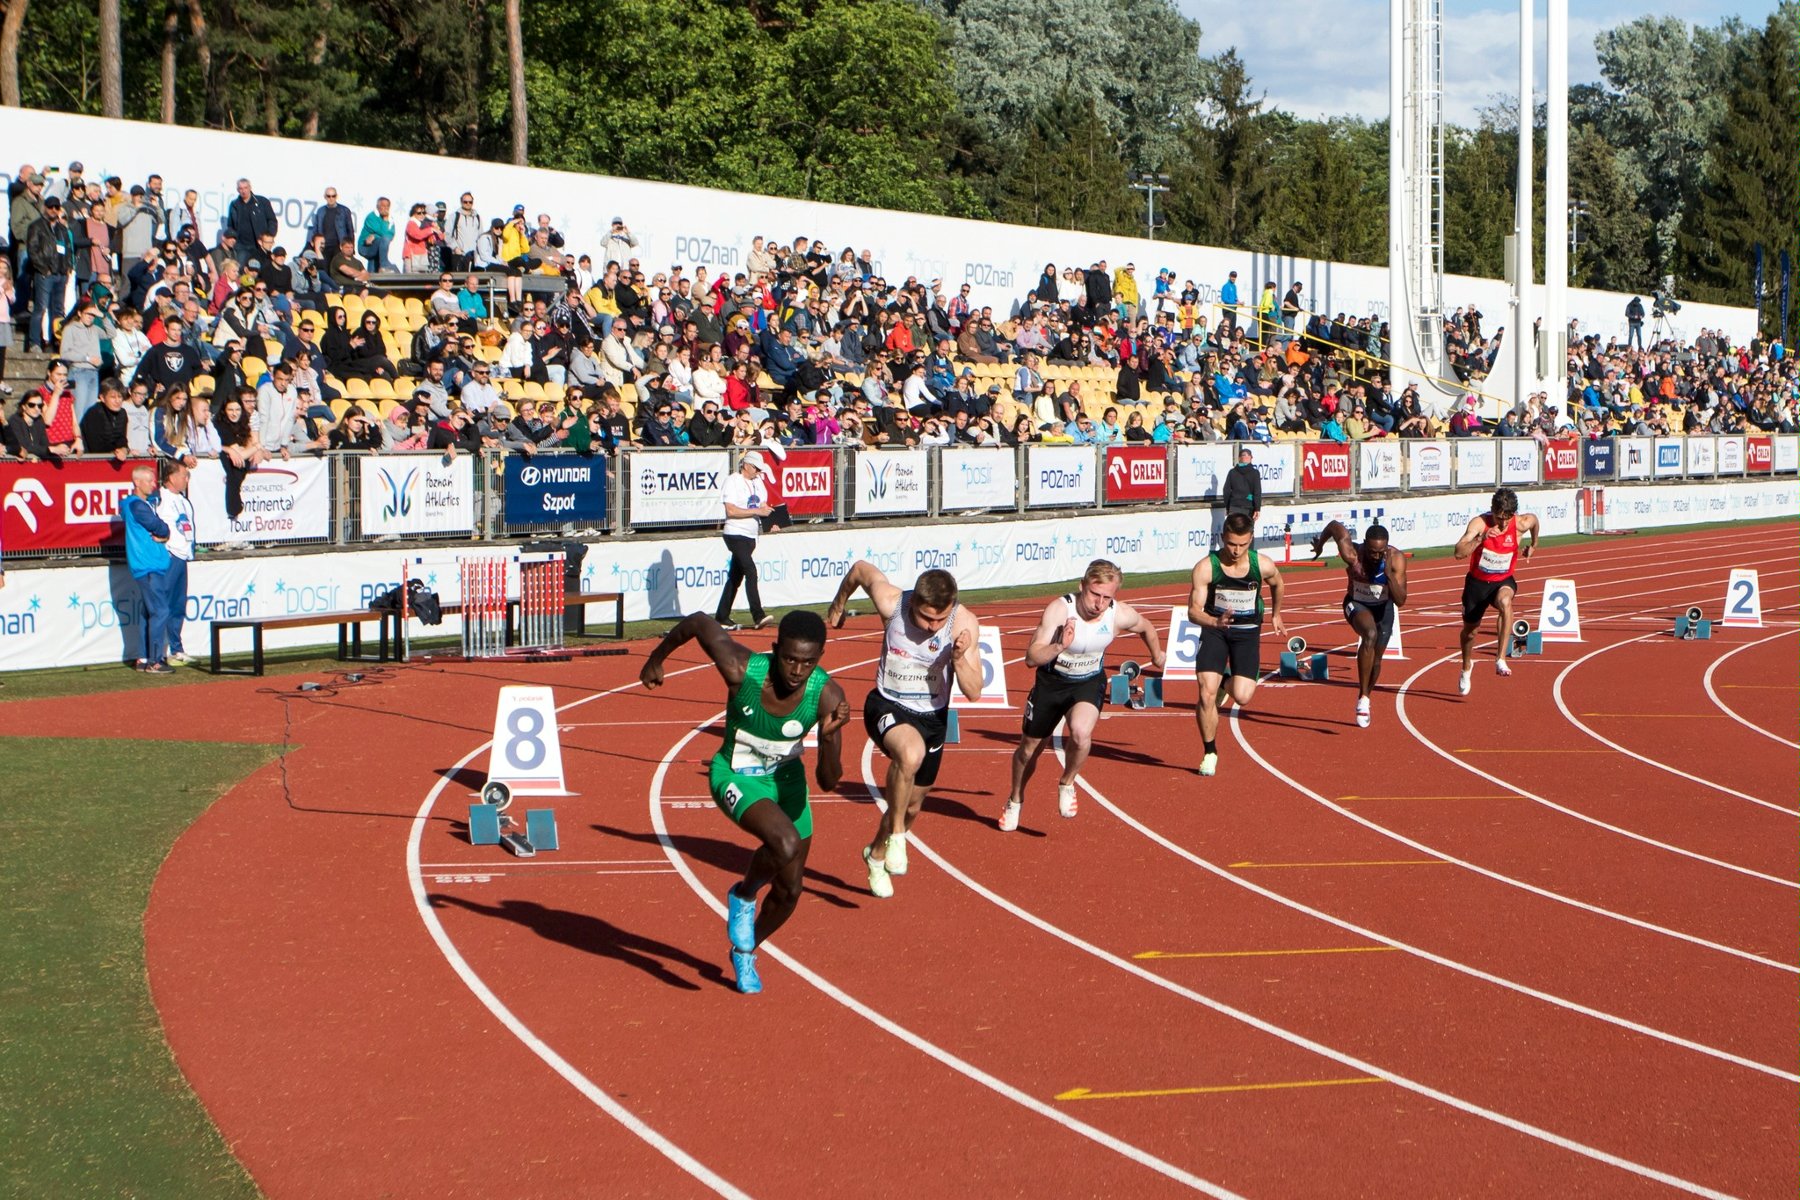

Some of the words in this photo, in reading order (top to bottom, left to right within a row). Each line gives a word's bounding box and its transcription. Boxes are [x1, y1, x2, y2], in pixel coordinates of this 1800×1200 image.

[675, 236, 739, 266] POZnan
[965, 262, 1014, 288] POZnan
[1323, 457, 1347, 473] ORLEN
[1508, 457, 1531, 471] POZnan
[1559, 452, 1576, 466] ORLEN
[542, 467, 591, 483] HYUNDAI
[657, 472, 719, 491] TAMEX
[785, 470, 827, 492] ORLEN
[1041, 468, 1081, 489] POZnan
[1132, 463, 1163, 481] ORLEN
[241, 494, 295, 512] ontinental
[425, 491, 460, 507] Athletics
[543, 493, 575, 514] Szpot
[1447, 512, 1470, 527] POZnan
[1547, 506, 1567, 520] POZnan
[255, 516, 293, 531] Bronze
[1391, 517, 1415, 532] POZnan
[1016, 542, 1056, 562] POZnan
[1106, 537, 1142, 555] POZnan
[802, 557, 850, 580] POZnan
[915, 549, 958, 570] POZnan
[619, 567, 661, 592] posir
[286, 577, 340, 614] posir
[1731, 580, 1753, 614] 2
[1548, 591, 1571, 628] 3
[1175, 619, 1201, 663] 5
[880, 715, 888, 727] 7
[505, 707, 546, 771] 8
[725, 789, 737, 806] 8
